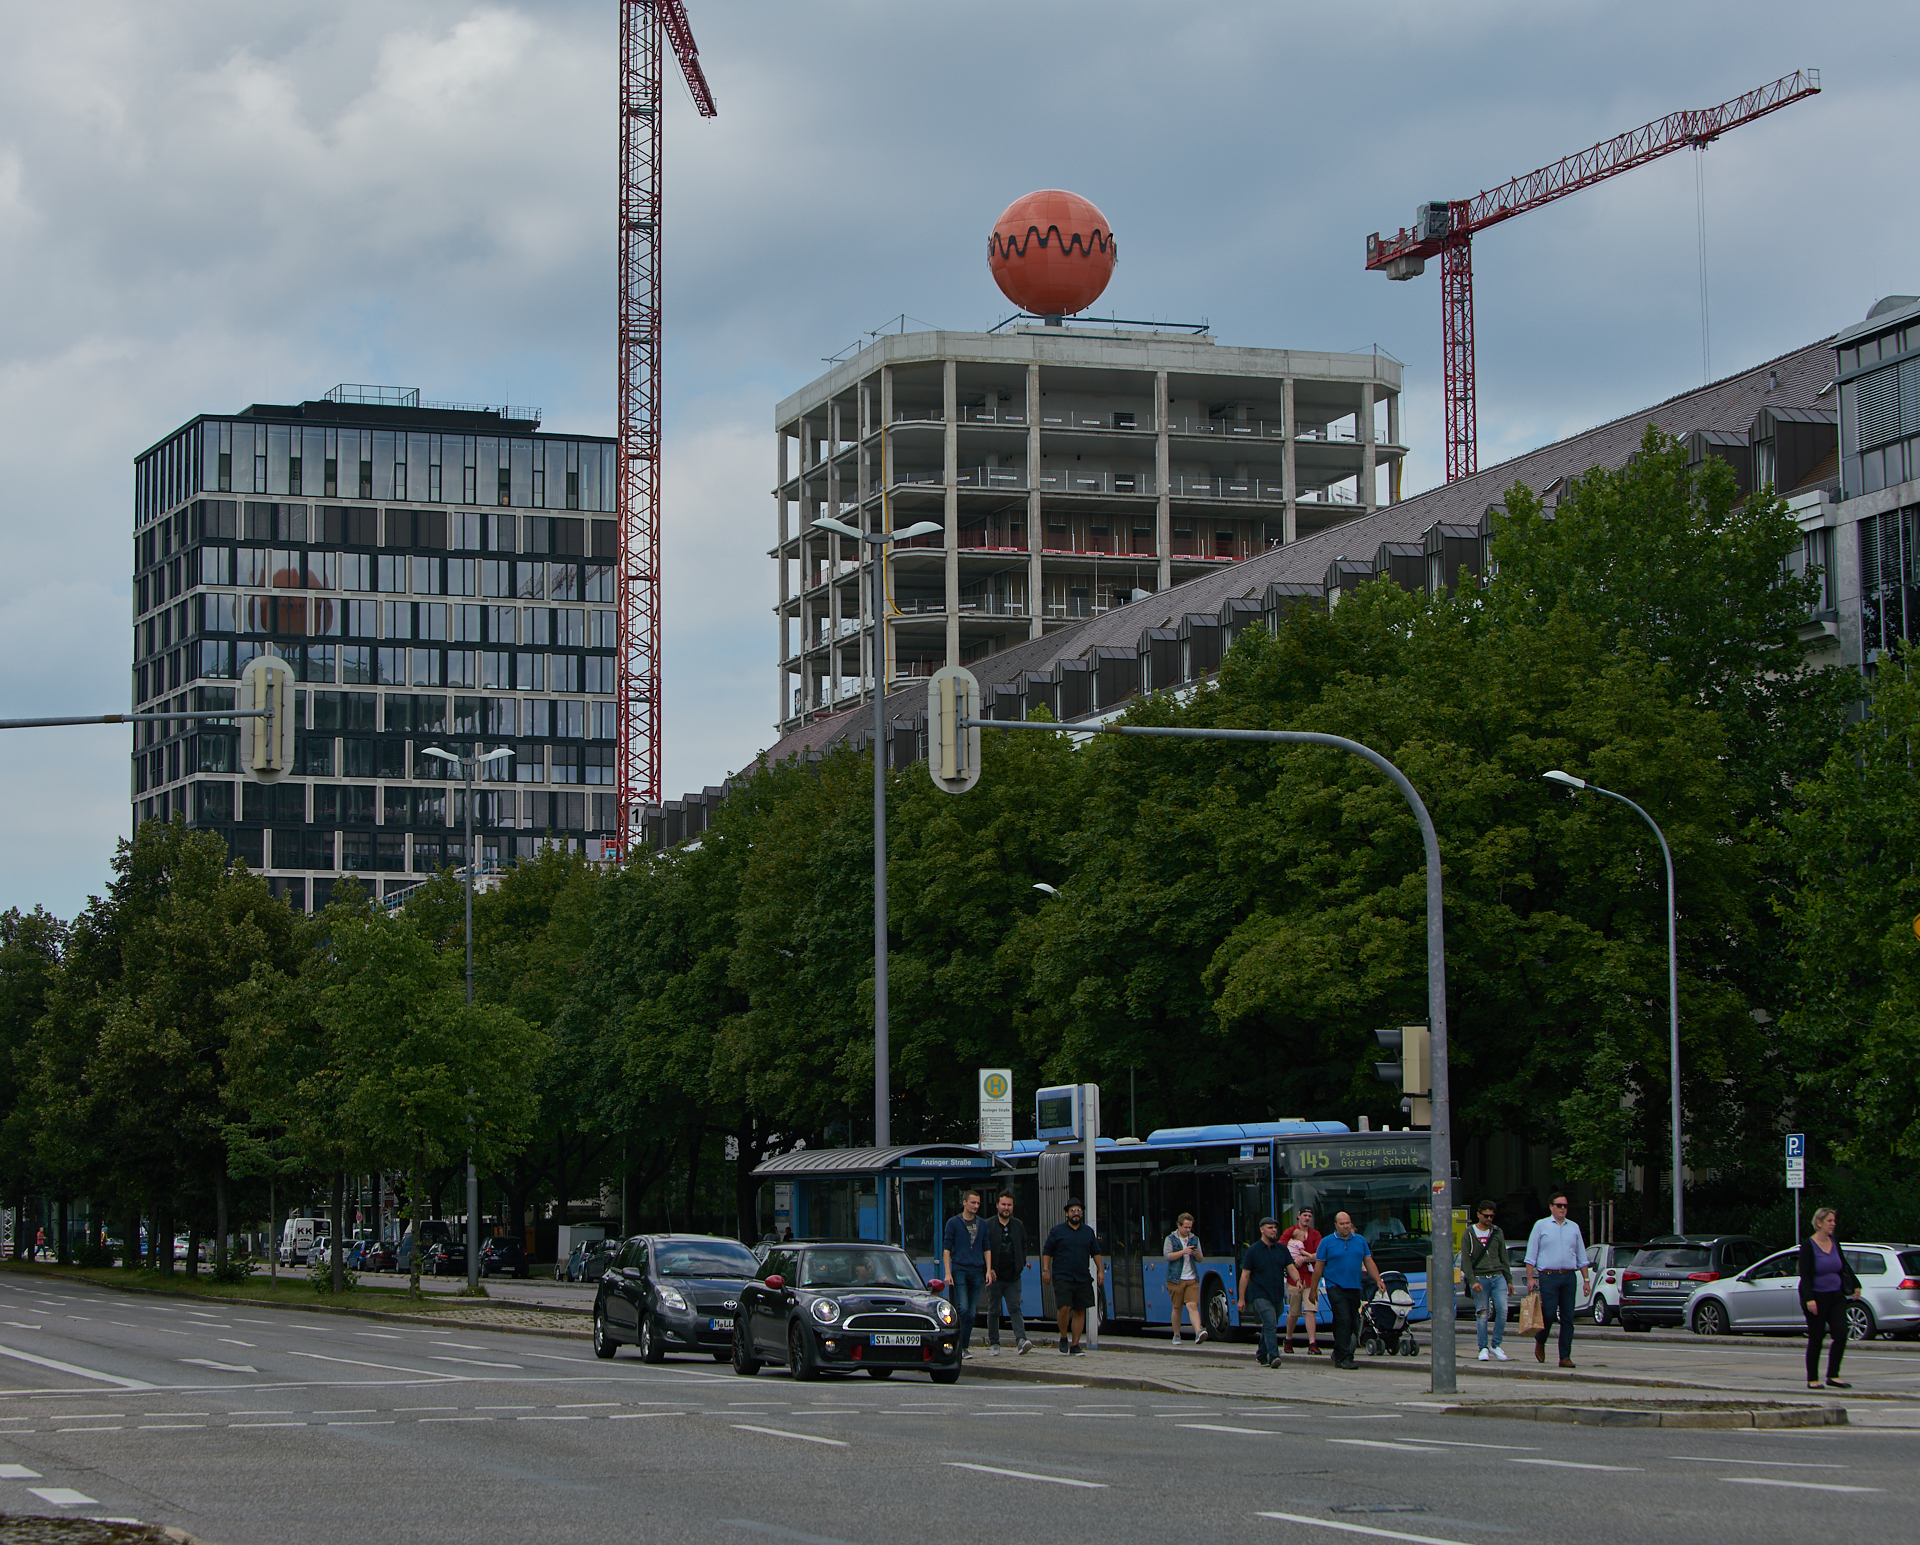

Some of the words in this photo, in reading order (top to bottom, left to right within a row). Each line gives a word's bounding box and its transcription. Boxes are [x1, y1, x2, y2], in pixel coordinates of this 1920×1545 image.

[631, 808, 639, 824] 1
[1788, 1137, 1799, 1155] P
[1339, 1147, 1397, 1157] Fasangarten
[920, 1158, 949, 1168] Anzinger
[950, 1158, 972, 1167] Straße
[1299, 1149, 1330, 1169] 145
[1341, 1157, 1377, 1168] Görzer
[1383, 1155, 1418, 1167] Schule
[714, 1319, 720, 1328] M
[875, 1335, 891, 1345] STA
[895, 1335, 905, 1345] AN
[906, 1335, 920, 1345] 999
